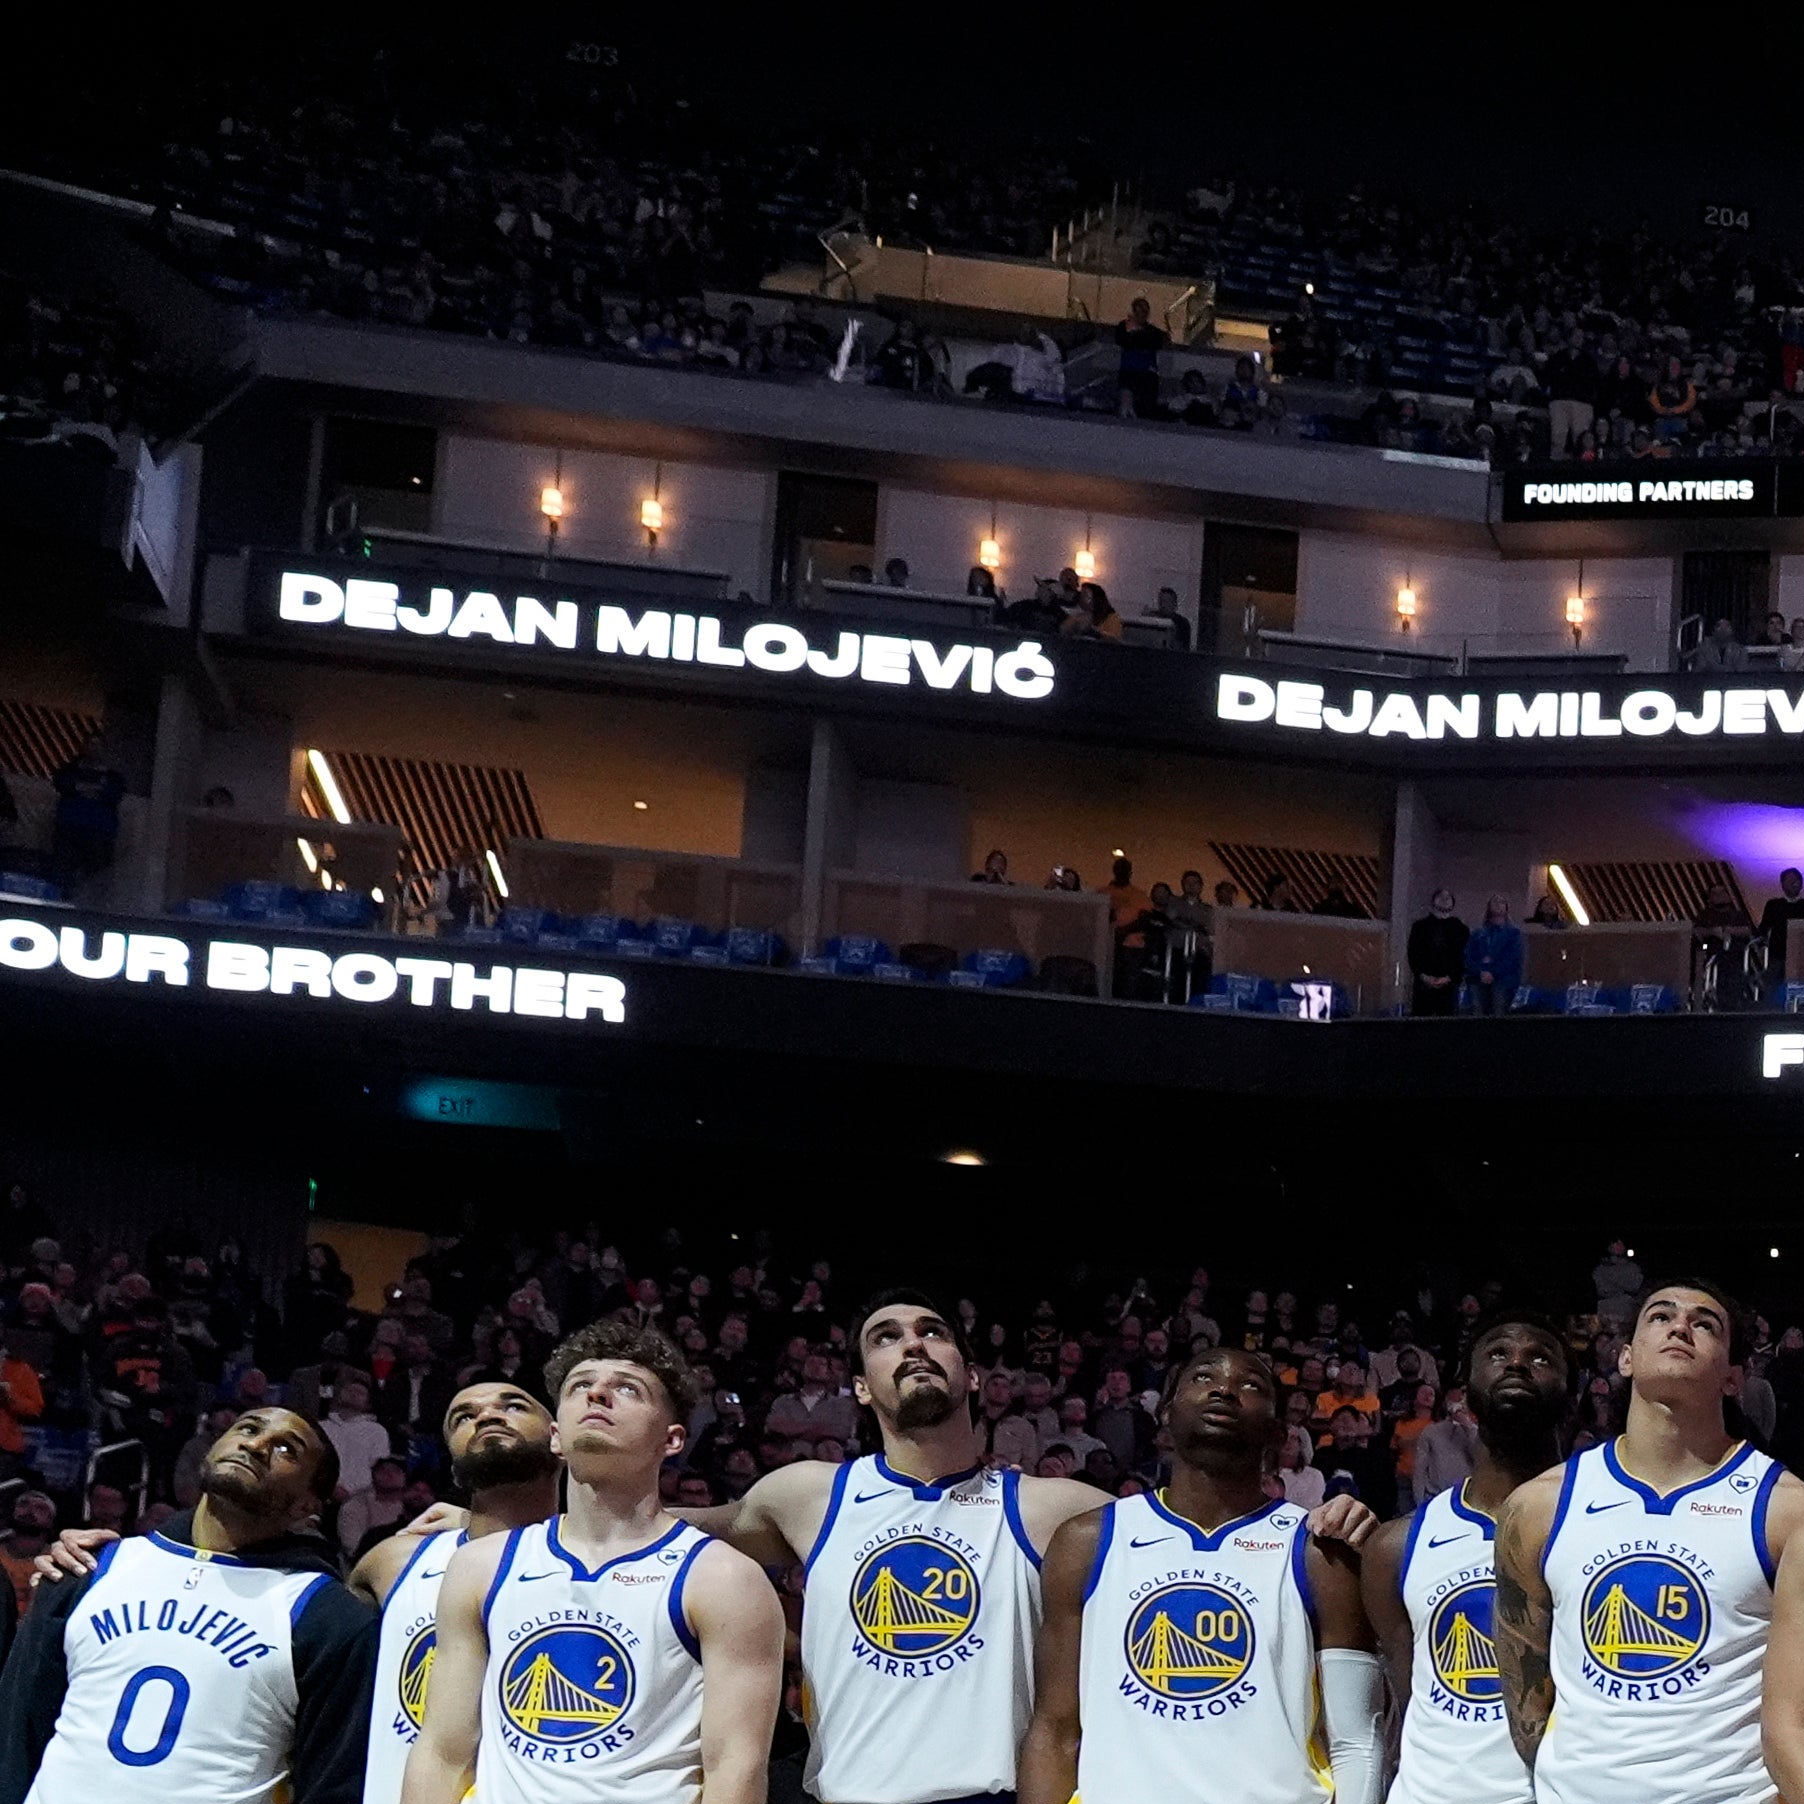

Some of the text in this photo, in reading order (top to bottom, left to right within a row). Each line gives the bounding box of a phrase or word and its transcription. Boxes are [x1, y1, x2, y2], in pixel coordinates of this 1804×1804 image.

[1704, 206, 1749, 231] 204
[1524, 479, 1754, 503] FOUNDING PARTNERS
[280, 572, 1055, 699] DEJAN MILOJEVIĆ
[1218, 674, 1480, 740] DEJAN
[0, 918, 626, 1023] OUR BROTHER
[950, 1490, 1000, 1506] Rakuten
[1690, 1502, 1743, 1516] Rakuten
[854, 1523, 981, 1563] GOLDEN STATE
[1234, 1538, 1284, 1551] Rakuten
[1581, 1540, 1716, 1581] GOLDEN STATE
[612, 1572, 665, 1586] Rakuten
[922, 1568, 967, 1599] 20
[1129, 1569, 1259, 1607] GOLDEN STATE
[1657, 1585, 1689, 1620] 15
[91, 1599, 278, 1670] MILOJEVIĆ
[508, 1610, 641, 1648] GOLDEN STATE
[1196, 1610, 1239, 1642] 00
[594, 1656, 616, 1689] 2
[851, 1633, 984, 1678] WARRIORS
[1119, 1673, 1257, 1721] WARRIORS
[1581, 1656, 1711, 1701] WARRIORS
[107, 1665, 190, 1767] 0
[1429, 1680, 1504, 1721] WARRI
